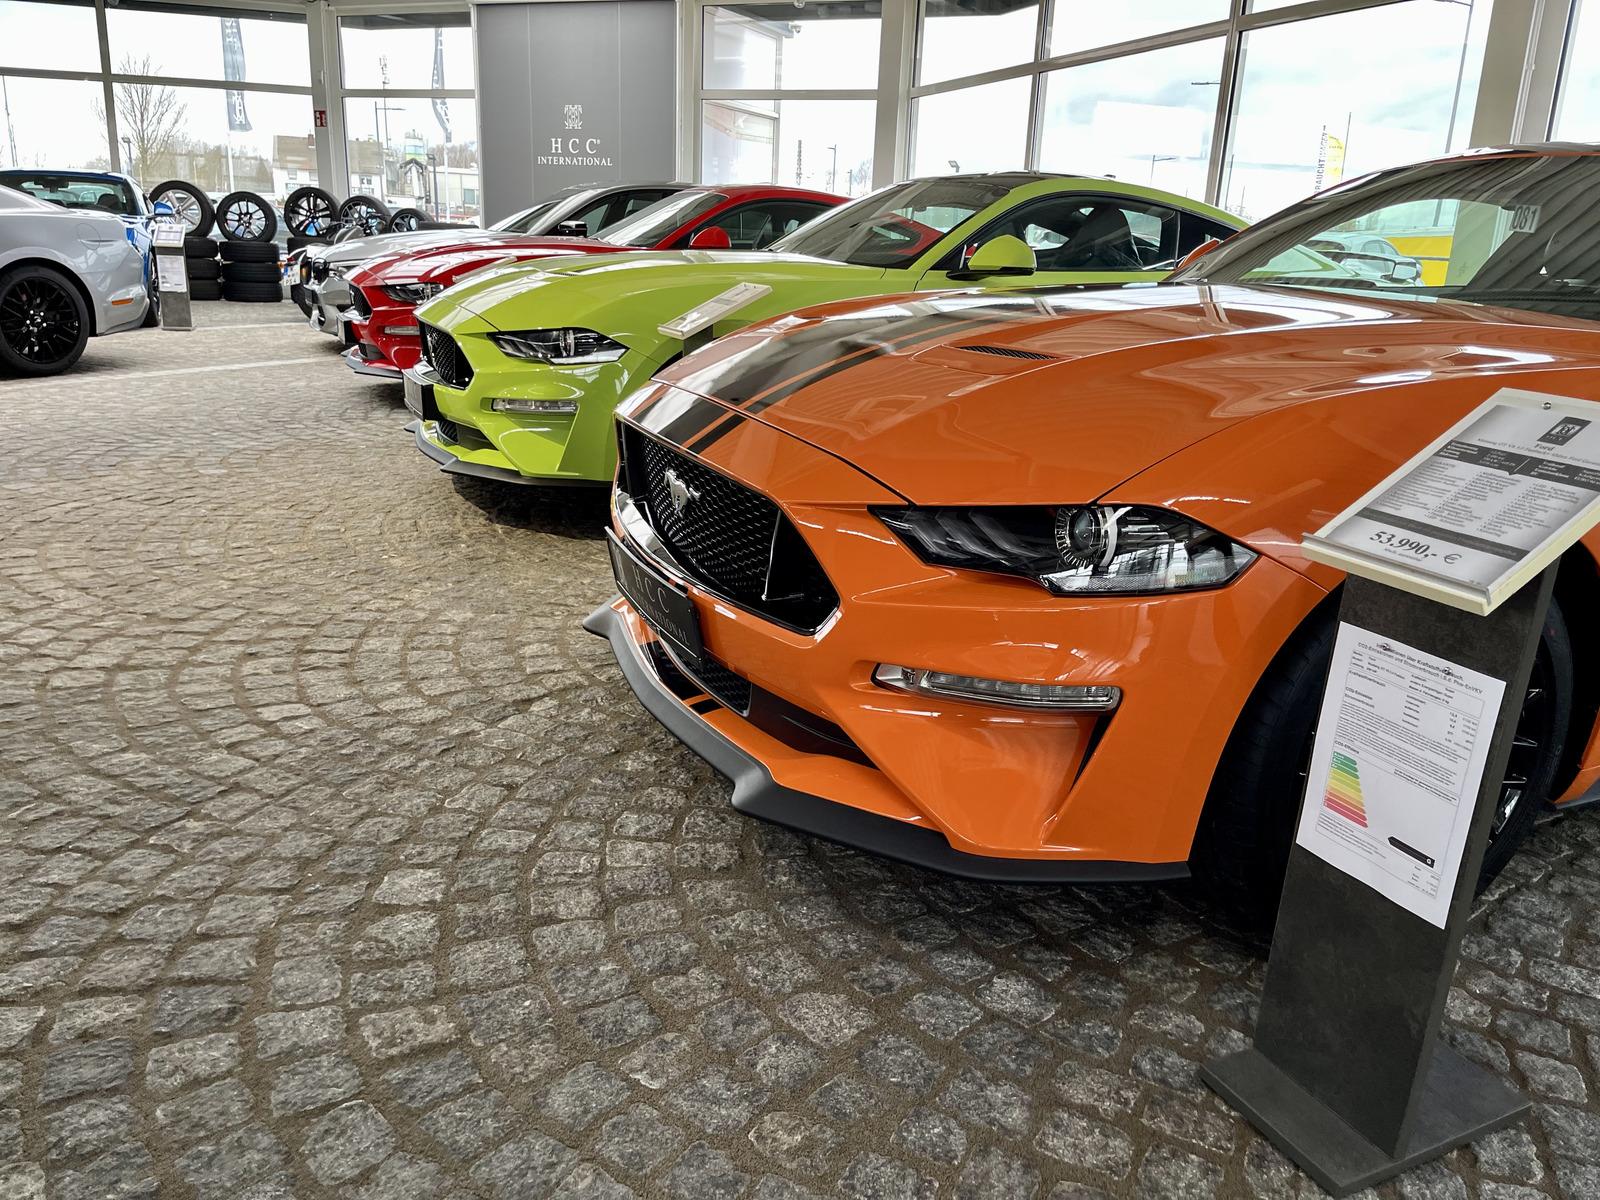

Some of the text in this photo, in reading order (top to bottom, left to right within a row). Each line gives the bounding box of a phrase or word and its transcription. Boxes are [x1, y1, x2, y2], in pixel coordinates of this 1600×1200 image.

[538, 156, 612, 166] INTERNATIONAL
[1512, 206, 1537, 230] 081
[1534, 443, 1556, 452] Ford
[1369, 530, 1437, 559] 53.990,-
[1443, 552, 1462, 565] €
